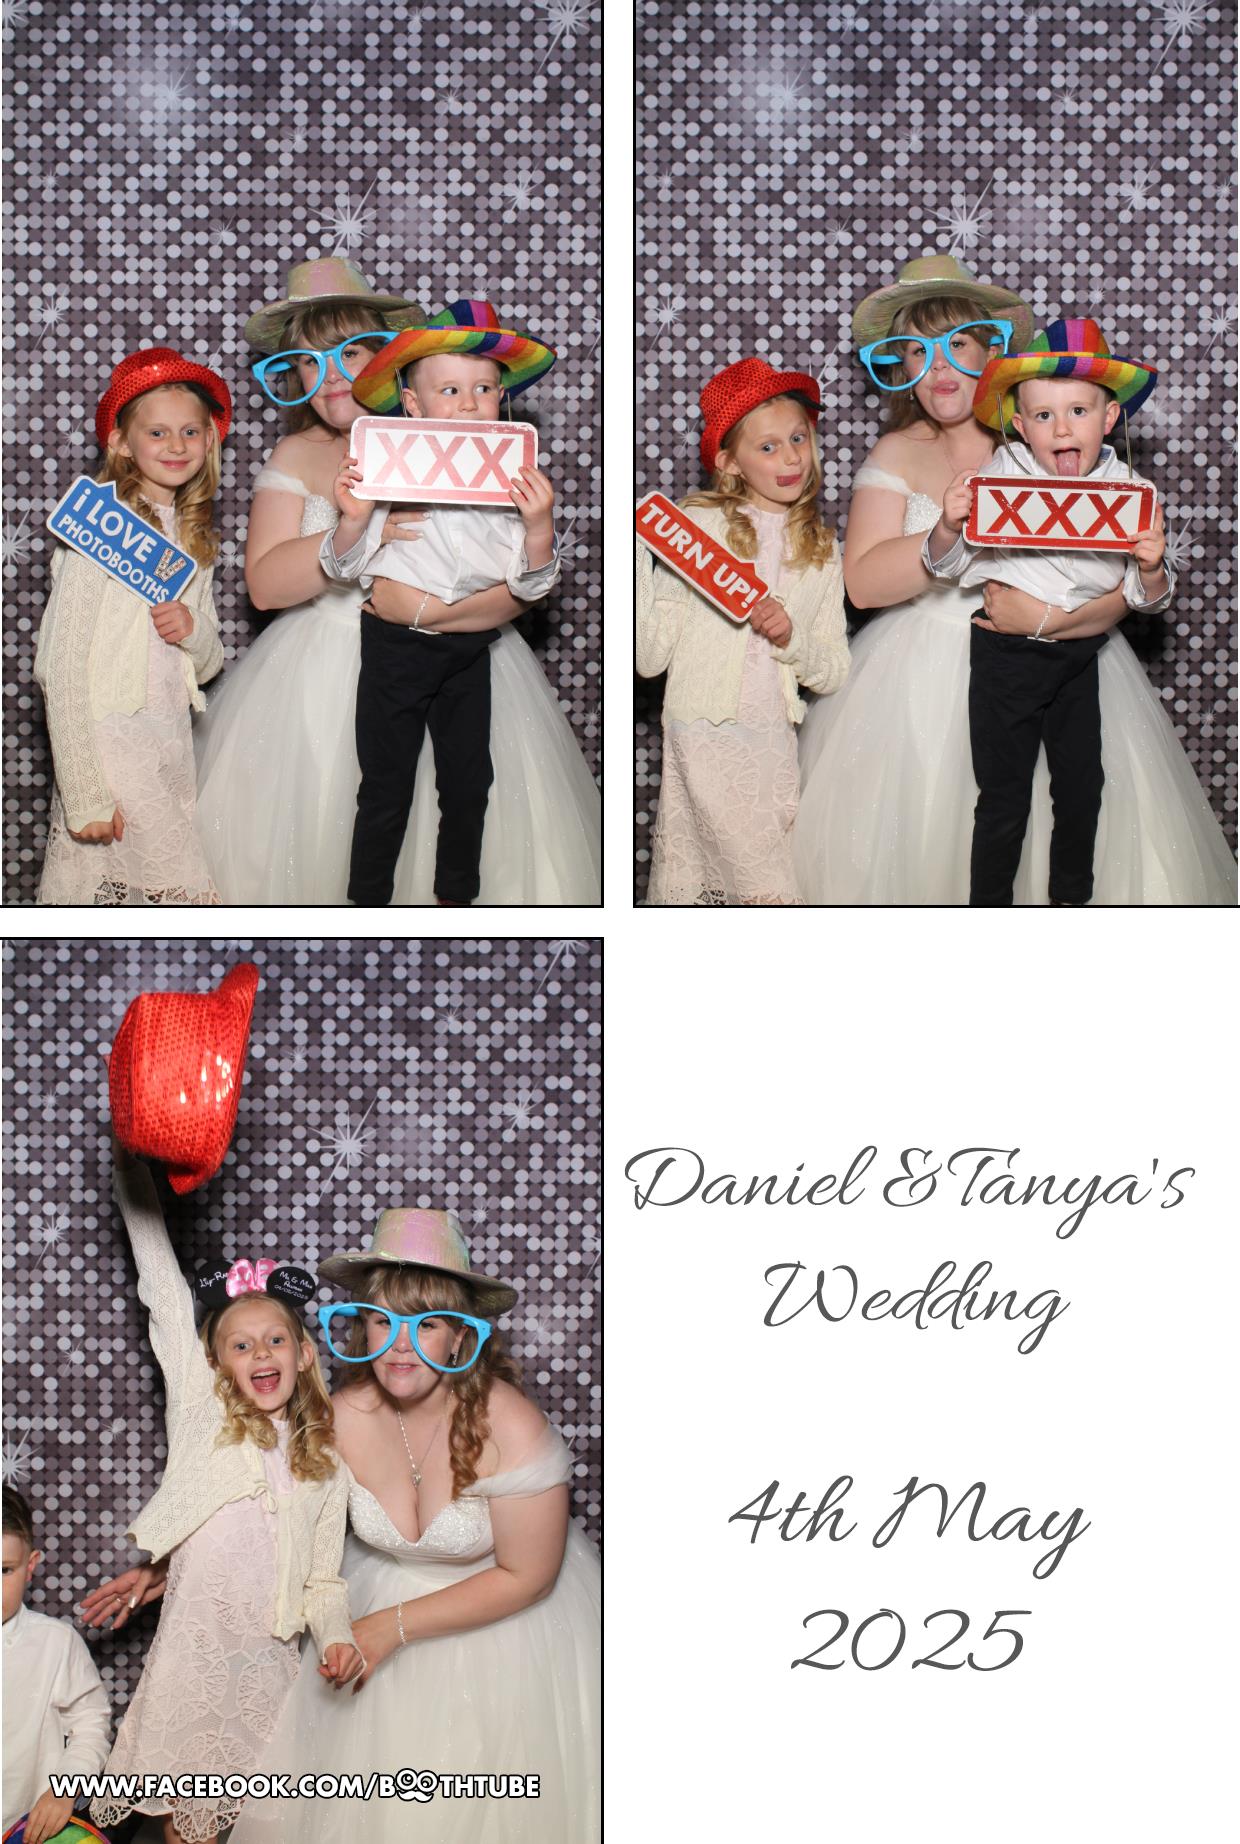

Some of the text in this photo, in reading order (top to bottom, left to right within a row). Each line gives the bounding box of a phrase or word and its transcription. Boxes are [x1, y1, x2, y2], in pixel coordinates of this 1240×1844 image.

[372, 432, 515, 490] XXX
[86, 499, 157, 563] LOVE
[985, 489, 1133, 540] XXX
[57, 513, 169, 603] PHOTOBOOTHS
[641, 502, 760, 609] TURN UP!
